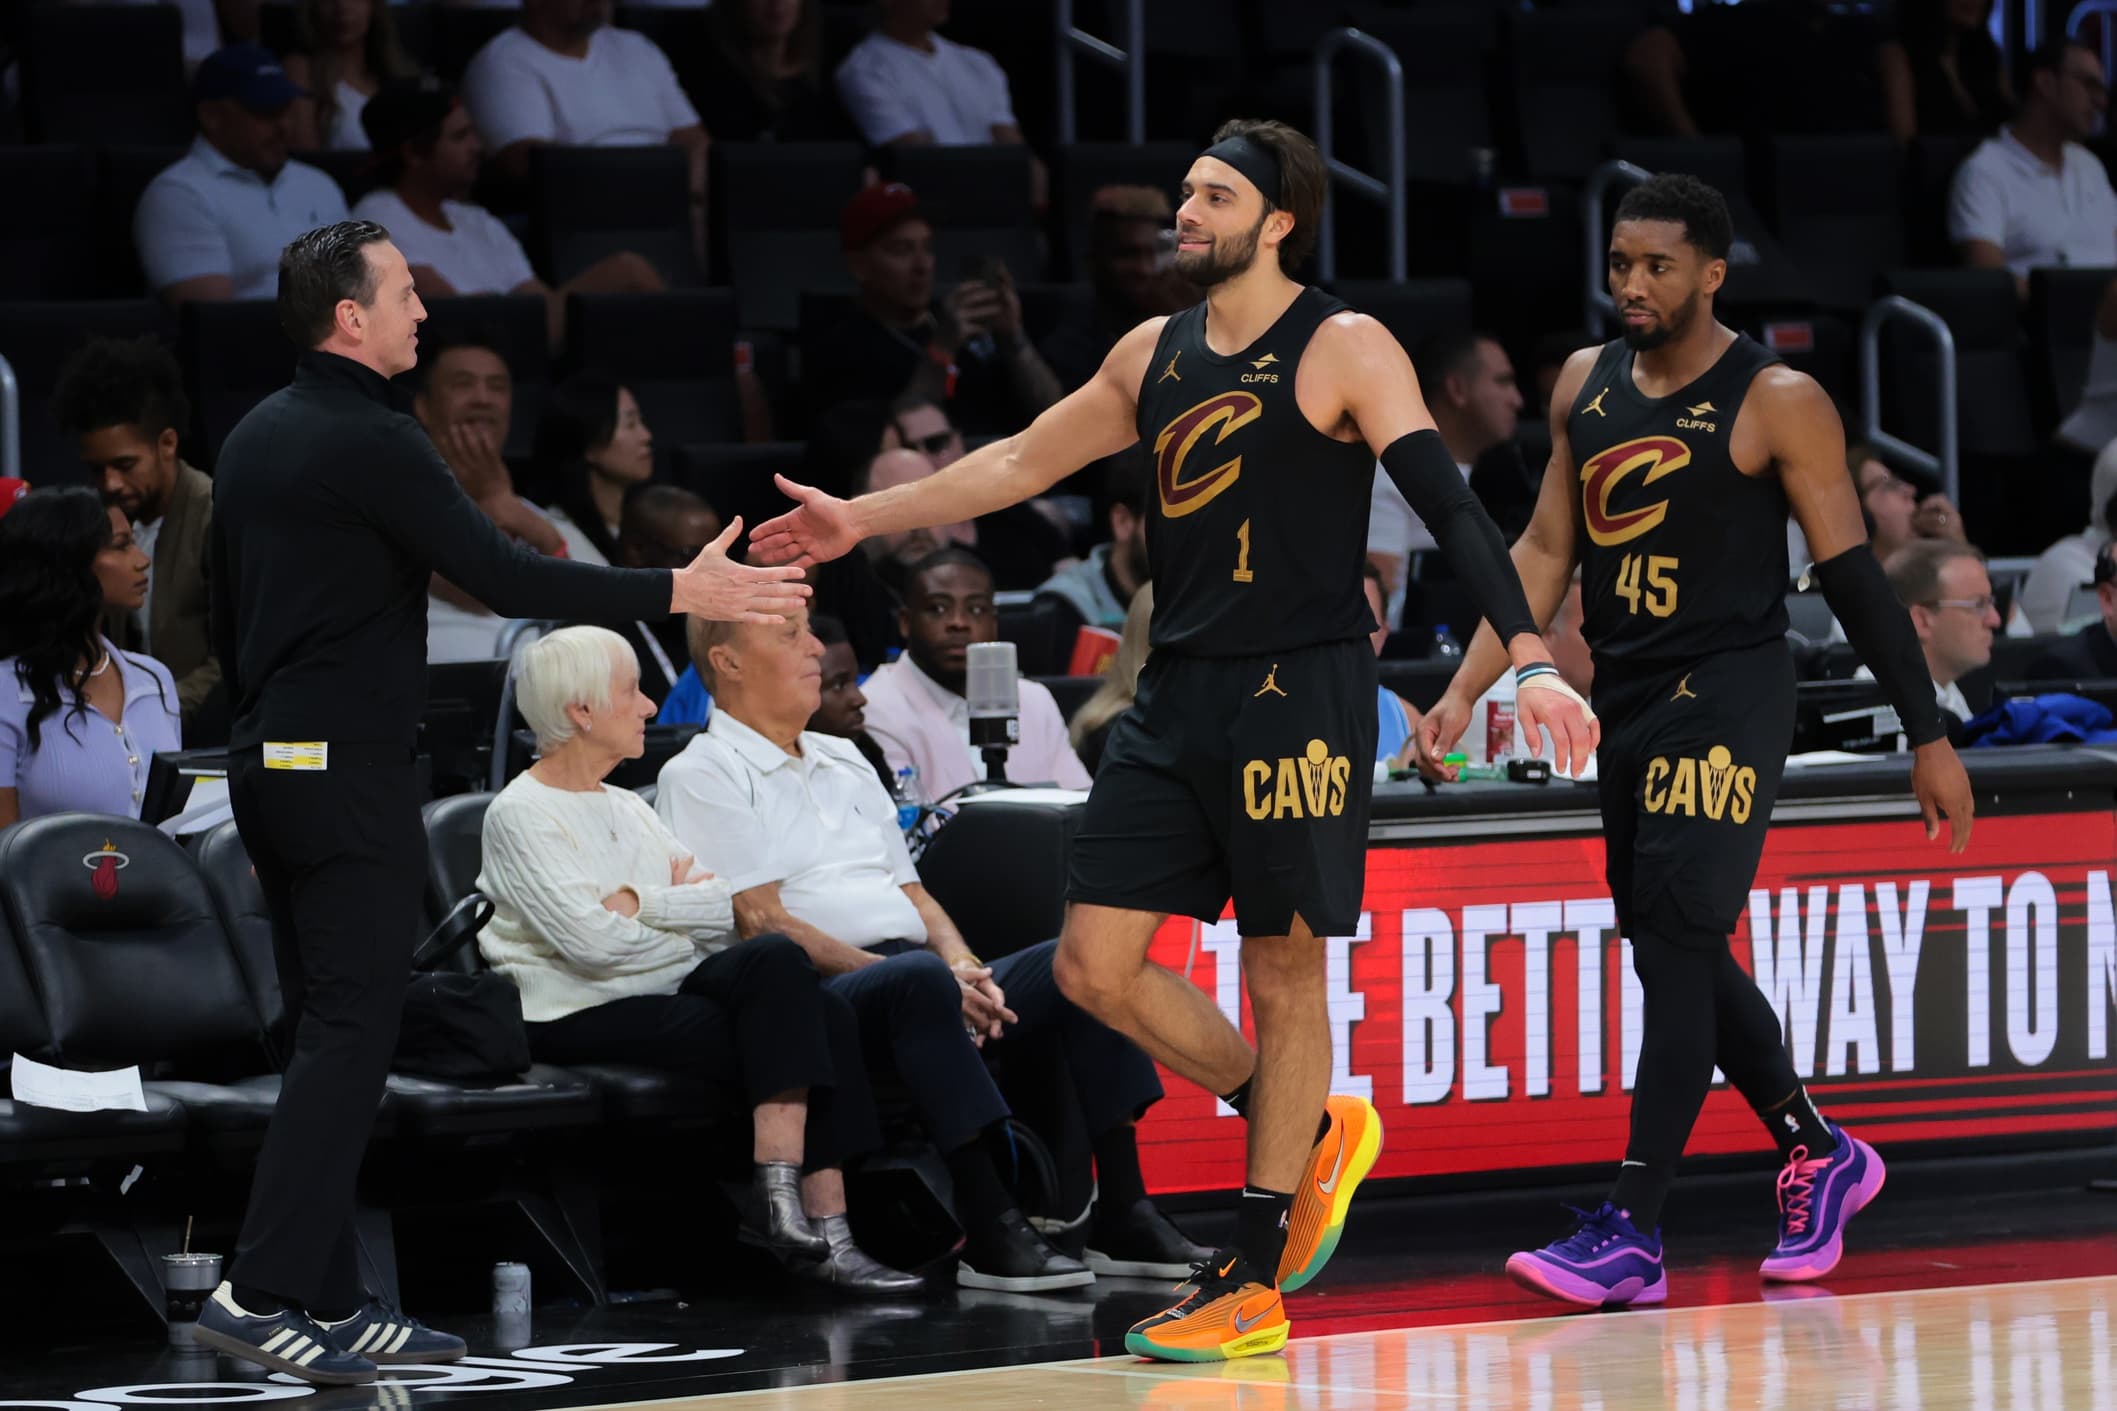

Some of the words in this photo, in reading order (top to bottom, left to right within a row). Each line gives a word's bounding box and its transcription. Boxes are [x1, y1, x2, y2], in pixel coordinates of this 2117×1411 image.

[1240, 373, 1279, 384] CLIFFS
[1153, 390, 1263, 518] C
[1676, 418, 1716, 432] CLIFFS
[1580, 435, 1692, 546] C
[1232, 517, 1254, 583] 1
[1615, 552, 1679, 618] 45
[1243, 756, 1351, 820] CAVS
[1644, 756, 1757, 824] CAVS
[1201, 911, 1372, 1117] TE
[1402, 897, 1725, 1105] BETT
[1749, 879, 1930, 1078] WAY
[1953, 870, 2058, 1067] TO
